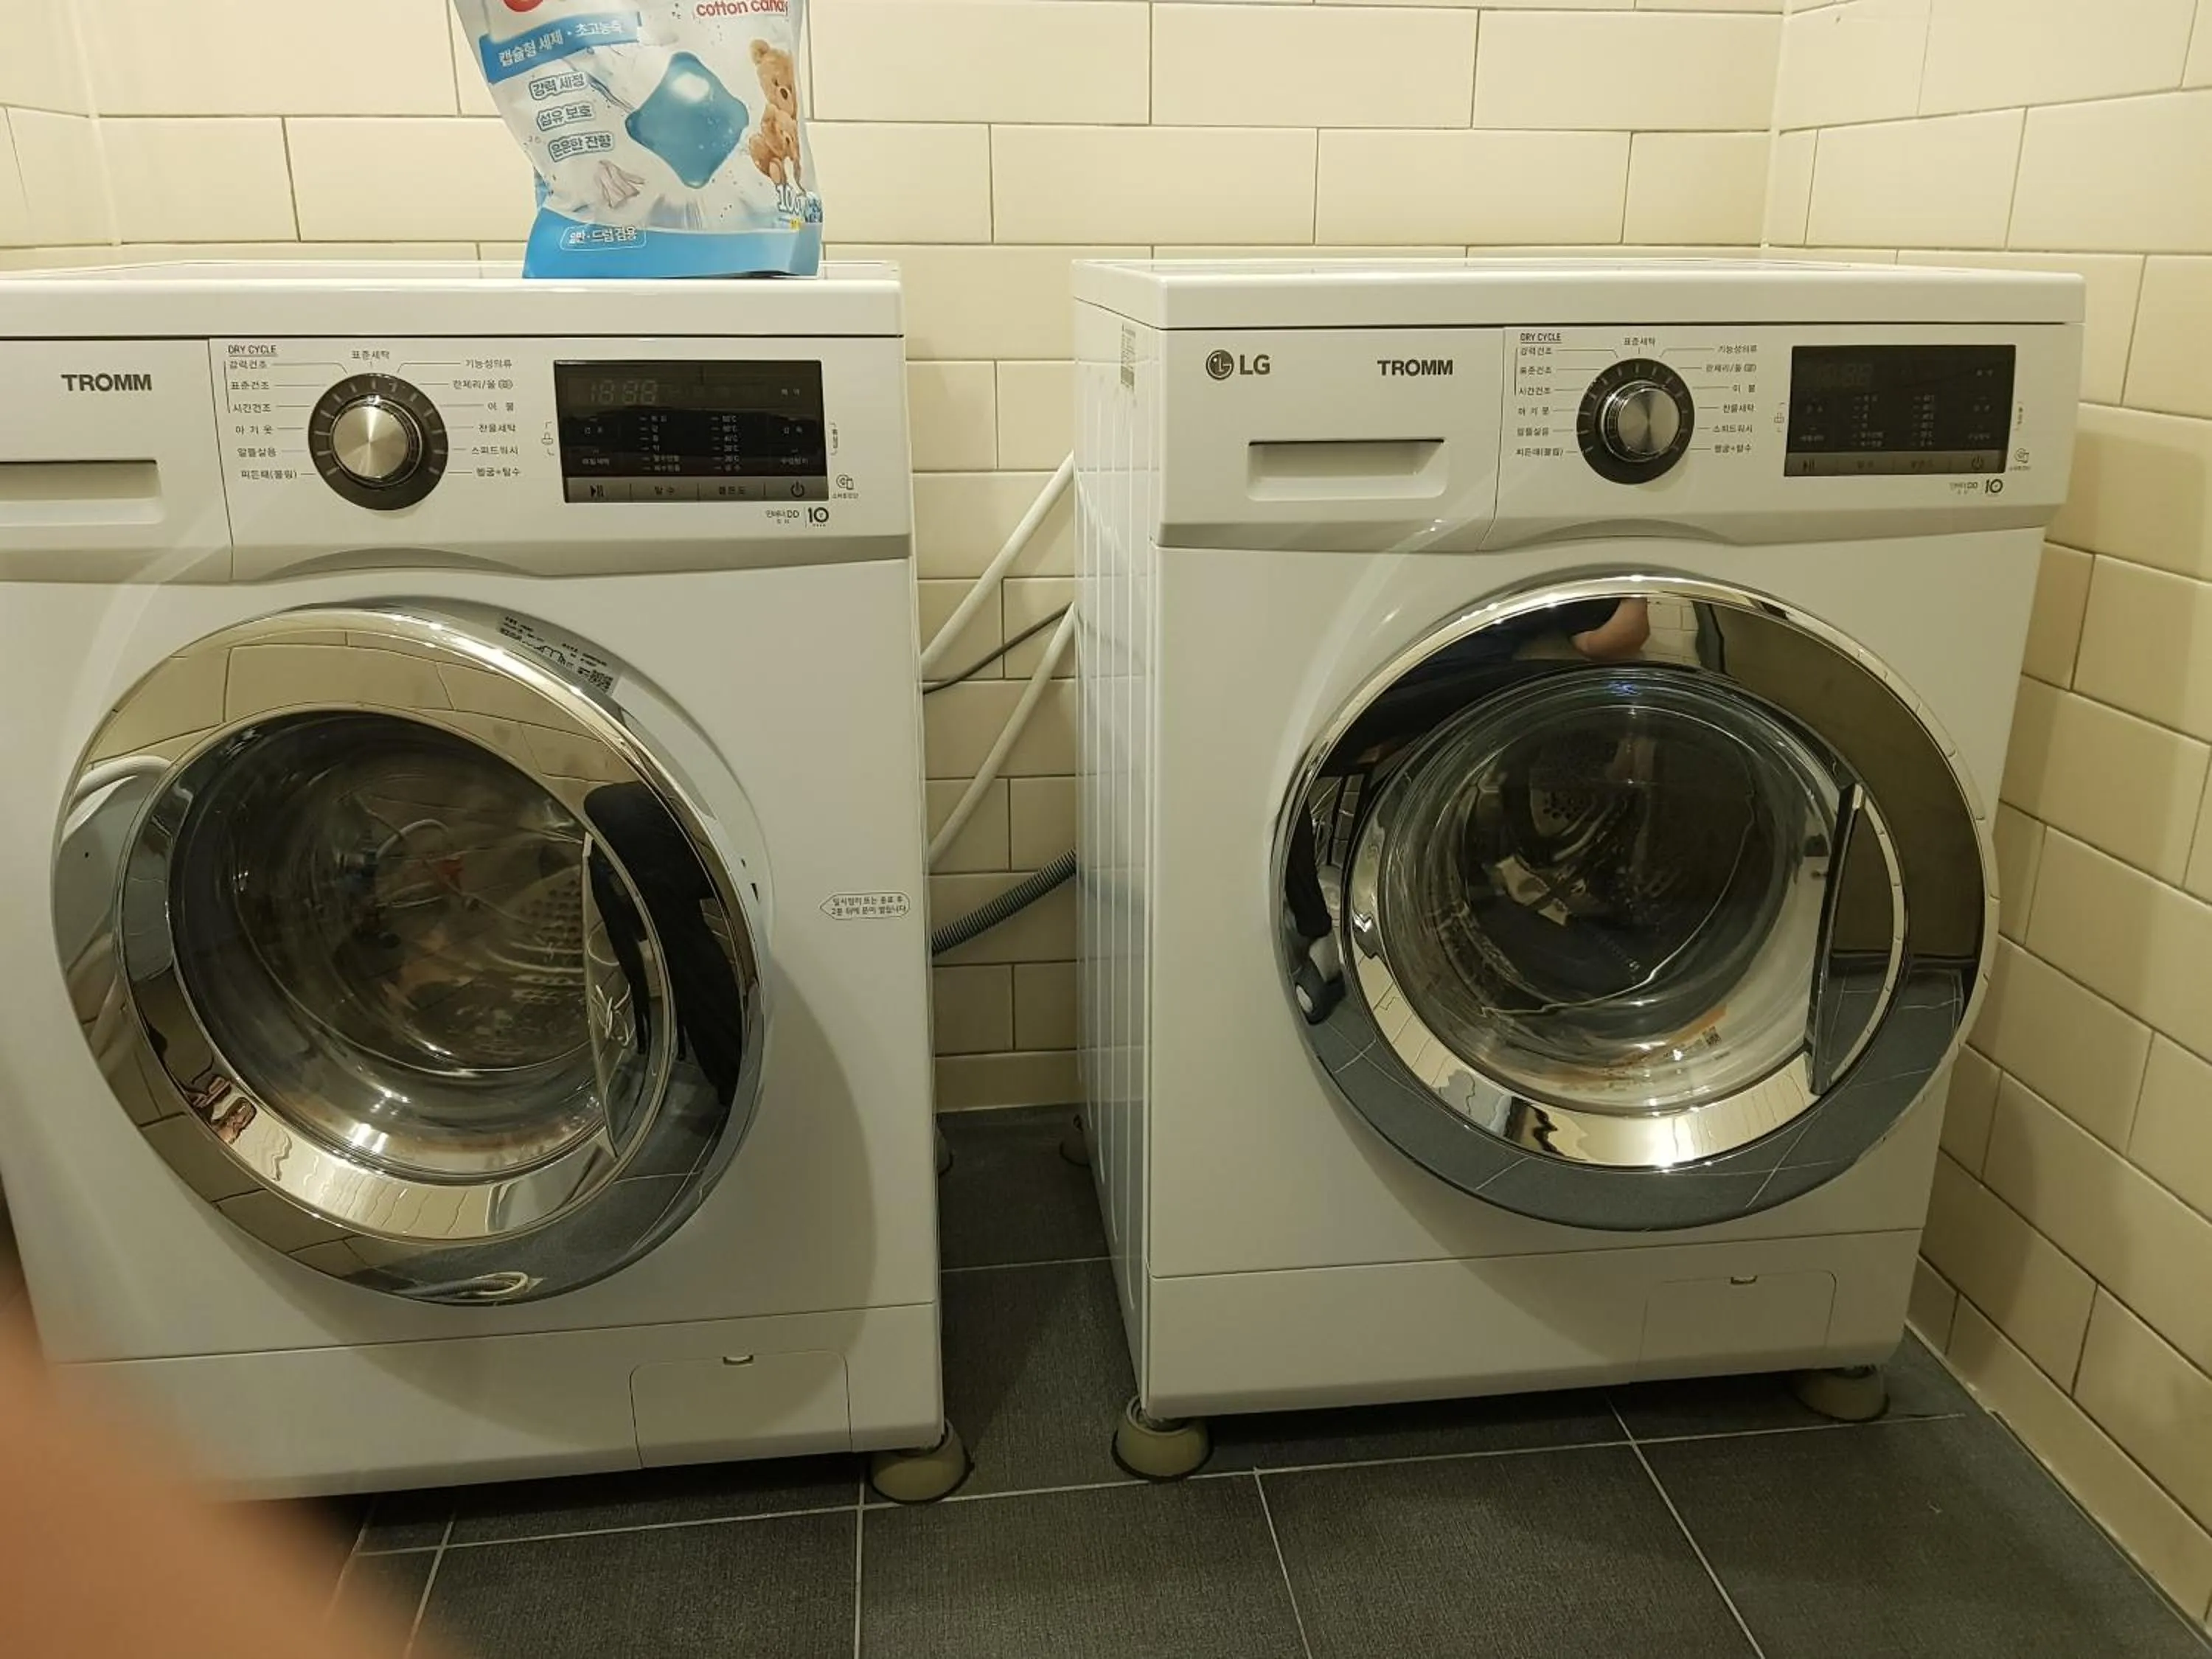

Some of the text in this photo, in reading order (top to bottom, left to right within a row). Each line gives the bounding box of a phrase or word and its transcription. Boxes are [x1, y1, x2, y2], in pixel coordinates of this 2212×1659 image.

[696, 0, 748, 16] cotton
[498, 39, 538, 68] 캡슐형
[538, 29, 565, 50] 세제
[531, 72, 585, 97] 강력 세정
[538, 105, 593, 128] 섬유 보호
[551, 133, 612, 159] 은은한 잔향
[1520, 333, 1562, 341] DRY CYCLE
[227, 344, 277, 355] DRY CYCLE
[351, 350, 390, 361] 표준세탁
[465, 358, 512, 369] 기능성의류
[1239, 354, 1271, 375] LG
[1377, 359, 1454, 377] TROMM
[60, 372, 153, 392] TROMM
[230, 380, 270, 390] 표준건조
[1519, 386, 1551, 396] 시간건조
[232, 403, 272, 414] 시간건조
[471, 445, 519, 456] 스피드워시
